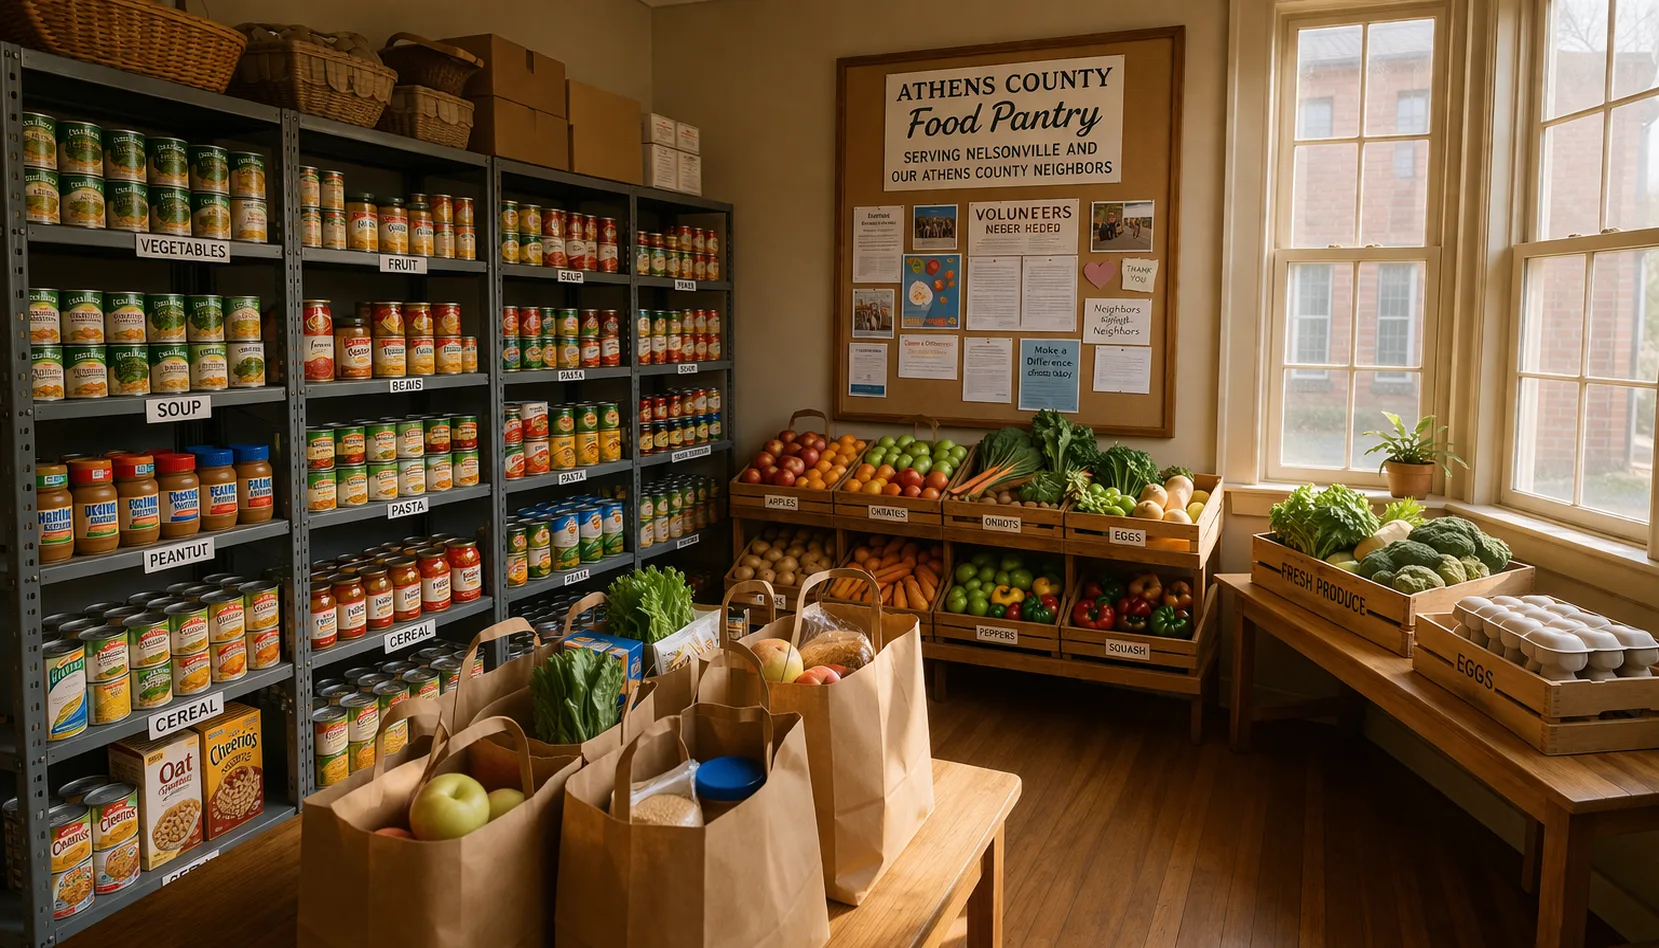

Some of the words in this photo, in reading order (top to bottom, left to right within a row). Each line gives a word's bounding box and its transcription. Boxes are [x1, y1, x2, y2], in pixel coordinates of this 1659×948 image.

[896, 76, 996, 102] ATHENS
[1005, 68, 1113, 94] COUNTY
[907, 102, 983, 139] Food
[989, 100, 1104, 138] Pantry
[903, 148, 961, 164] SERVING
[966, 143, 1060, 160] NELSONVILLE
[1066, 142, 1098, 156] AND
[891, 170, 917, 183] OUR
[922, 168, 971, 181] ATHENS
[975, 165, 1028, 179] COUNTY
[1033, 161, 1113, 176] NEIGHBORS
[975, 206, 1073, 221] VOLUNEERS
[140, 238, 226, 258] VEGETABLES
[388, 258, 418, 271] FRUIT
[1126, 265, 1153, 274] THANK
[1130, 275, 1147, 283] YOU
[1093, 304, 1142, 316] Neighbors
[157, 400, 202, 418] SOUP
[391, 501, 425, 516] PASTA
[1114, 530, 1141, 543] EGGS
[150, 543, 208, 568] PEANTUT
[1281, 562, 1313, 592] FRESH
[1316, 577, 1366, 616] PRODUCE
[390, 624, 431, 647] CEREAL
[980, 628, 1015, 640] PEPPERS
[1109, 643, 1146, 656] SQUASH
[1457, 653, 1494, 690] EGGS
[155, 699, 218, 732] CEREAL
[209, 731, 258, 767] Cheerios
[159, 753, 193, 784] Oat
